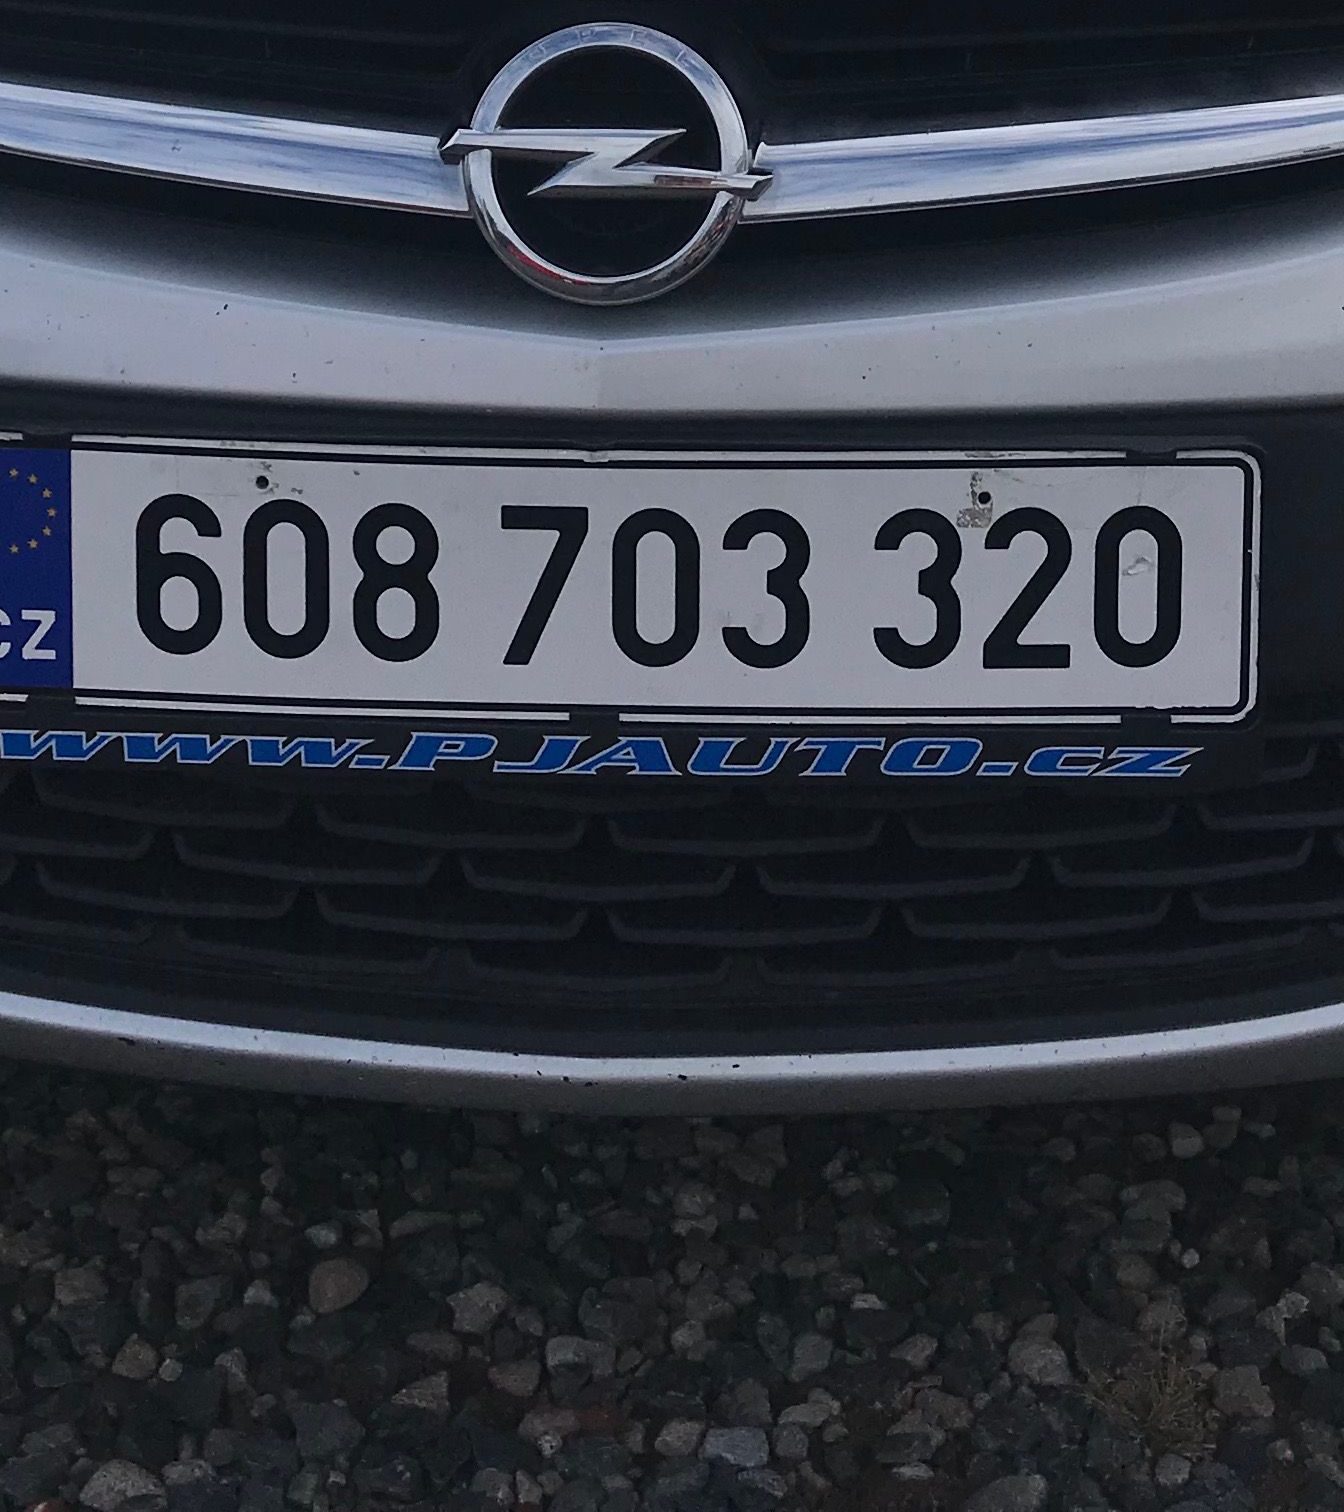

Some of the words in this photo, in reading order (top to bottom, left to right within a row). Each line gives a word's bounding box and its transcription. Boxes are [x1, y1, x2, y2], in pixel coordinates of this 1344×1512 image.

[135, 493, 441, 663] 608
[500, 504, 811, 669] 703
[872, 505, 1183, 670] 320
